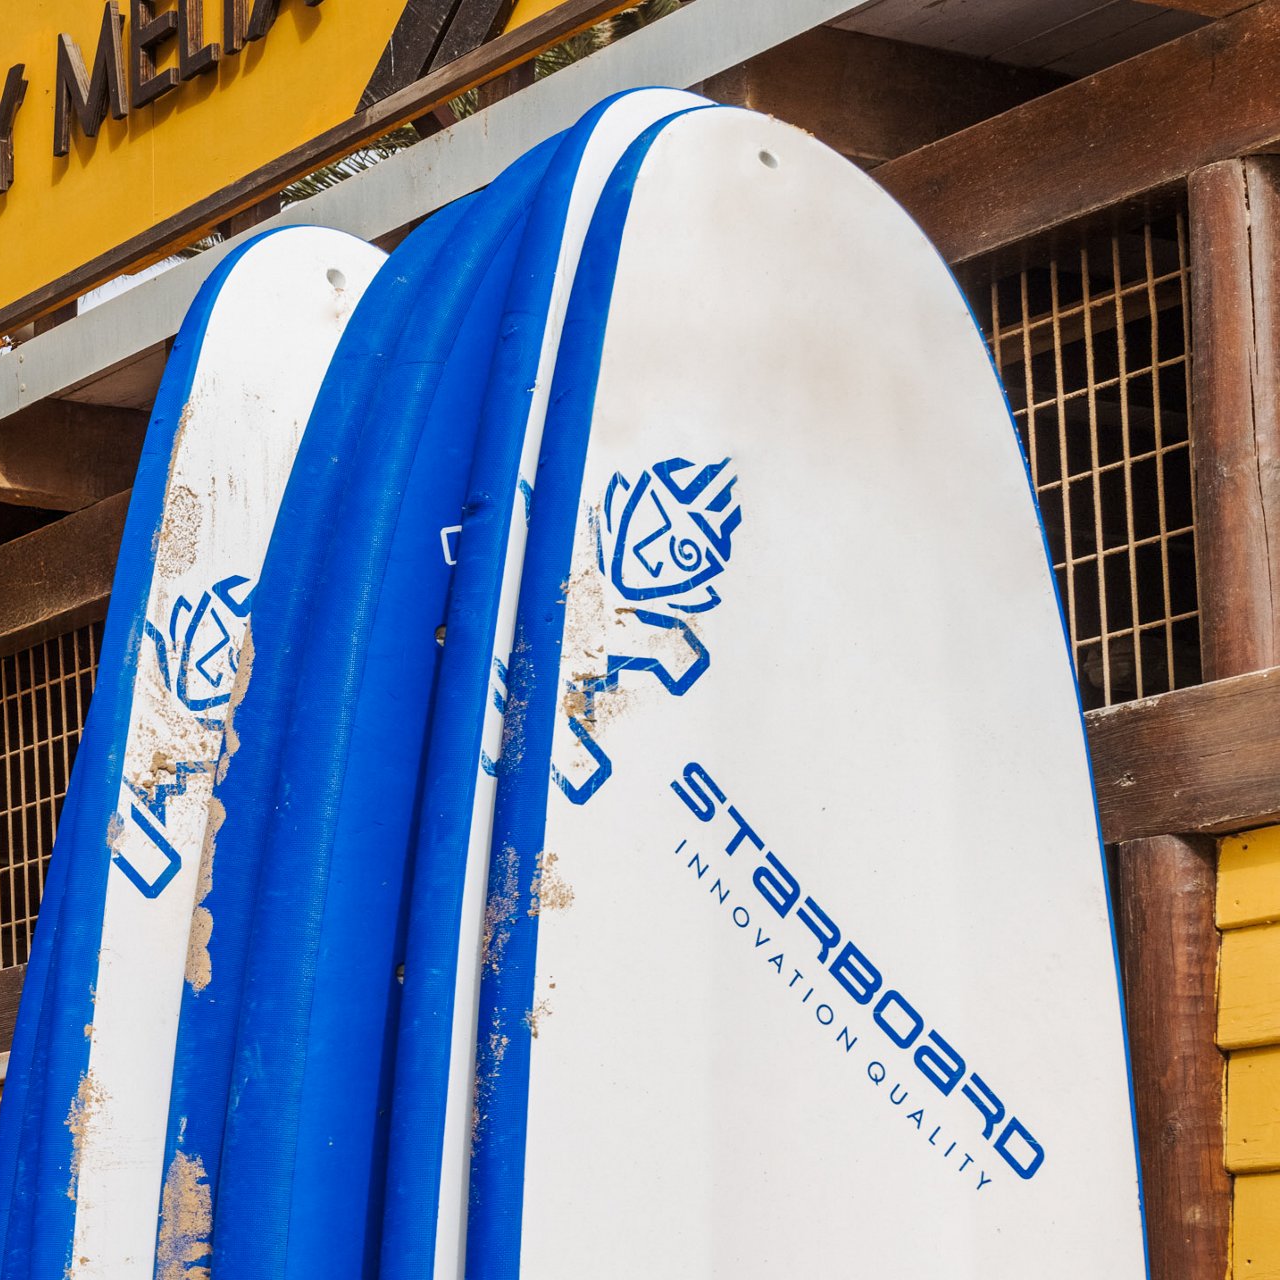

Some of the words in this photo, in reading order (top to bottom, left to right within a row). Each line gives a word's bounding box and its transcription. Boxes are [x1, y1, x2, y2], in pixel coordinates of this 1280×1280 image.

[54, 0, 321, 157] MEL
[675, 839, 858, 1052] INNOVATION
[867, 1061, 992, 1190] QUALITY
